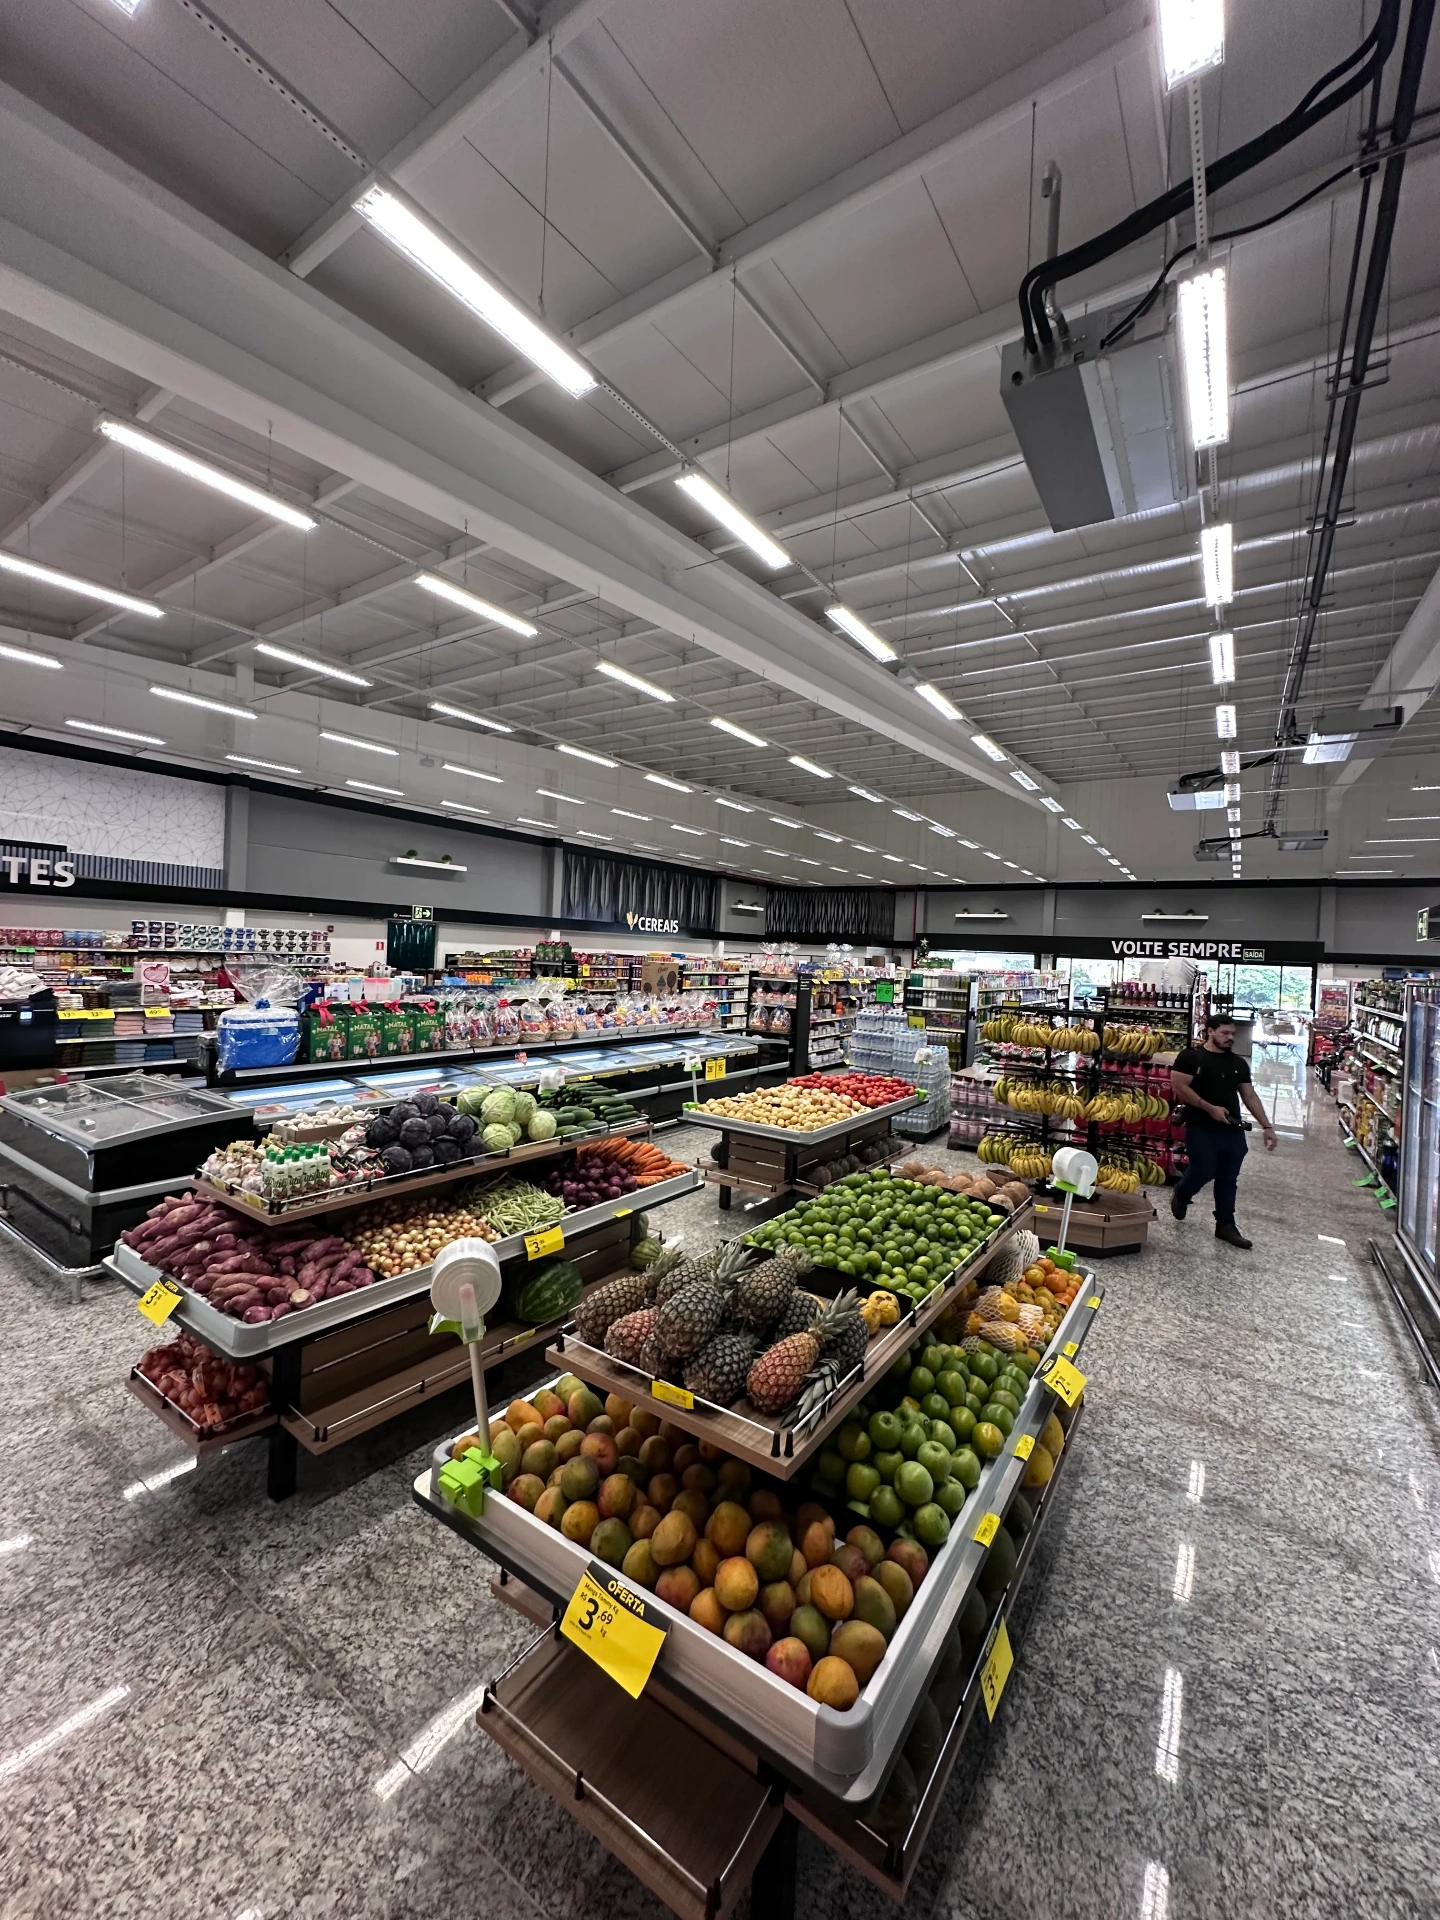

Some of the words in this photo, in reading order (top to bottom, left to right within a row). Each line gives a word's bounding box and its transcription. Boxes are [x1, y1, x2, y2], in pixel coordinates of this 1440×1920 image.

[2, 855, 76, 888] TES
[638, 916, 679, 934] CEREAIS
[1111, 940, 1164, 956] VOLTE
[1167, 941, 1242, 958] SEMPRE
[1244, 950, 1264, 959] SAÍDA
[354, 1023, 375, 1031] NATAL
[388, 1021, 408, 1029] NATAL
[420, 1019, 439, 1027] NATAL
[598, 1593, 612, 1610] Tommy
[608, 1580, 646, 1617] OFERTA
[600, 1625, 607, 1638] kg
